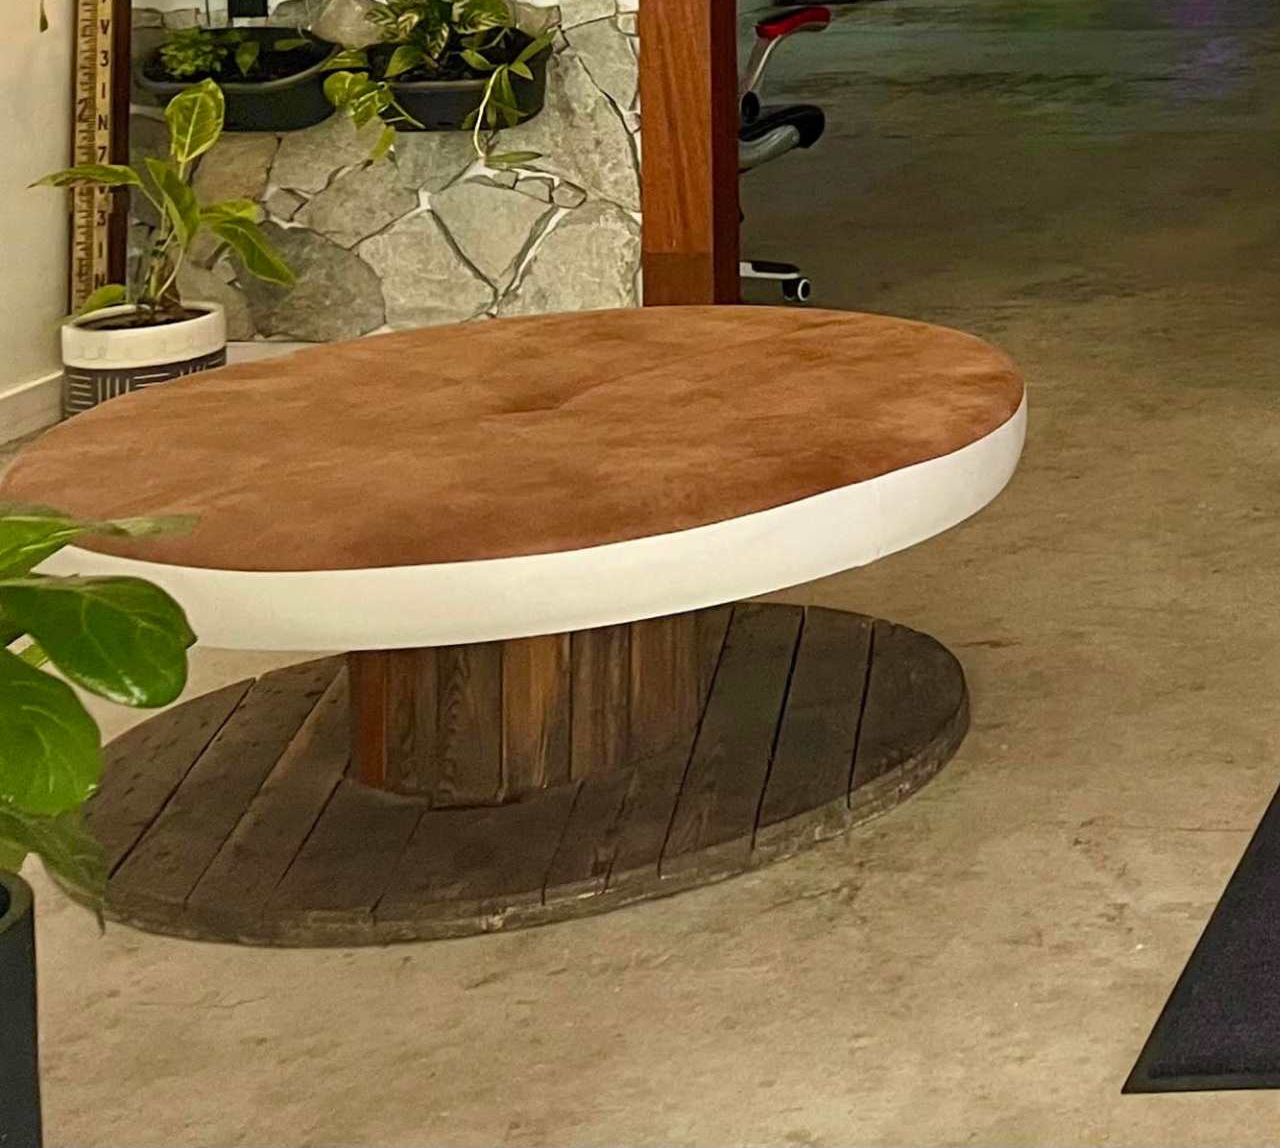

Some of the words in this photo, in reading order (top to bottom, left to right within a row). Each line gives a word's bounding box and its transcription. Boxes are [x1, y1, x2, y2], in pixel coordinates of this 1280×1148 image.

[99, 19, 110, 35] V
[99, 50, 110, 67] 3
[97, 114, 108, 131] N
